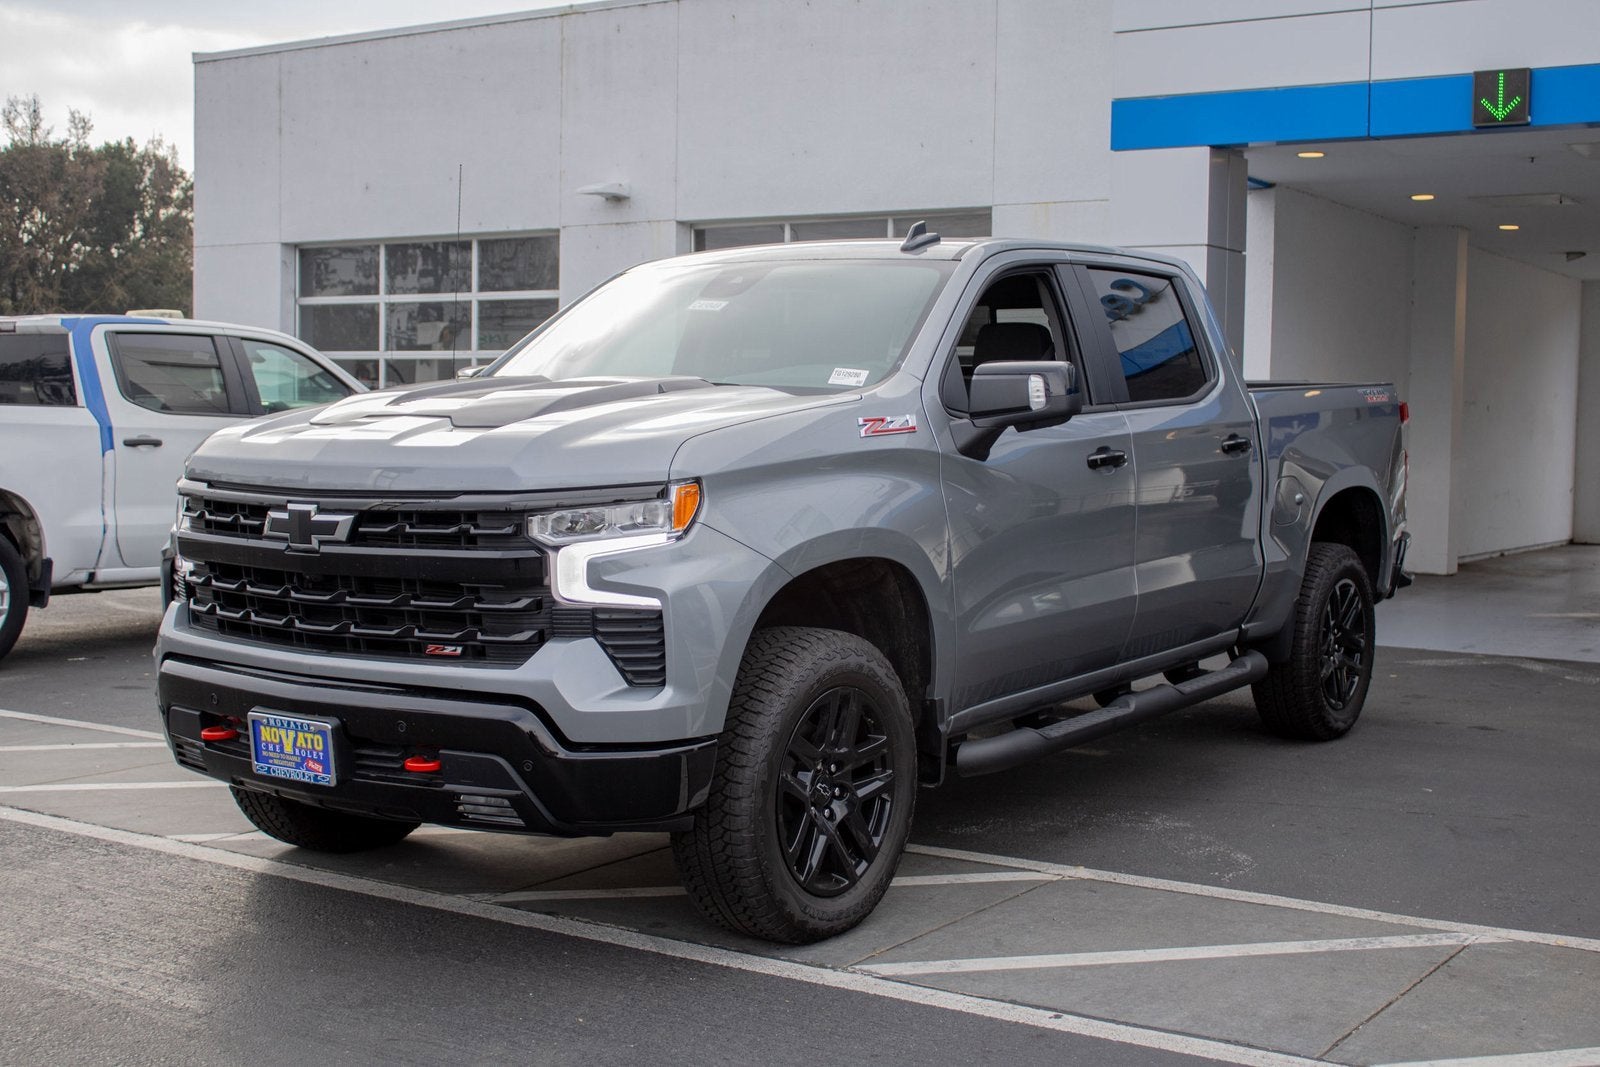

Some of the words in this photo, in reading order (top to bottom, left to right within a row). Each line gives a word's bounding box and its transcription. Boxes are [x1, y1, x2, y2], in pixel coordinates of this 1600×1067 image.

[857, 414, 918, 437] Z71
[268, 718, 309, 730] NOVATO
[260, 726, 323, 754] NOVATO
[270, 767, 315, 782] CHEVROLET
